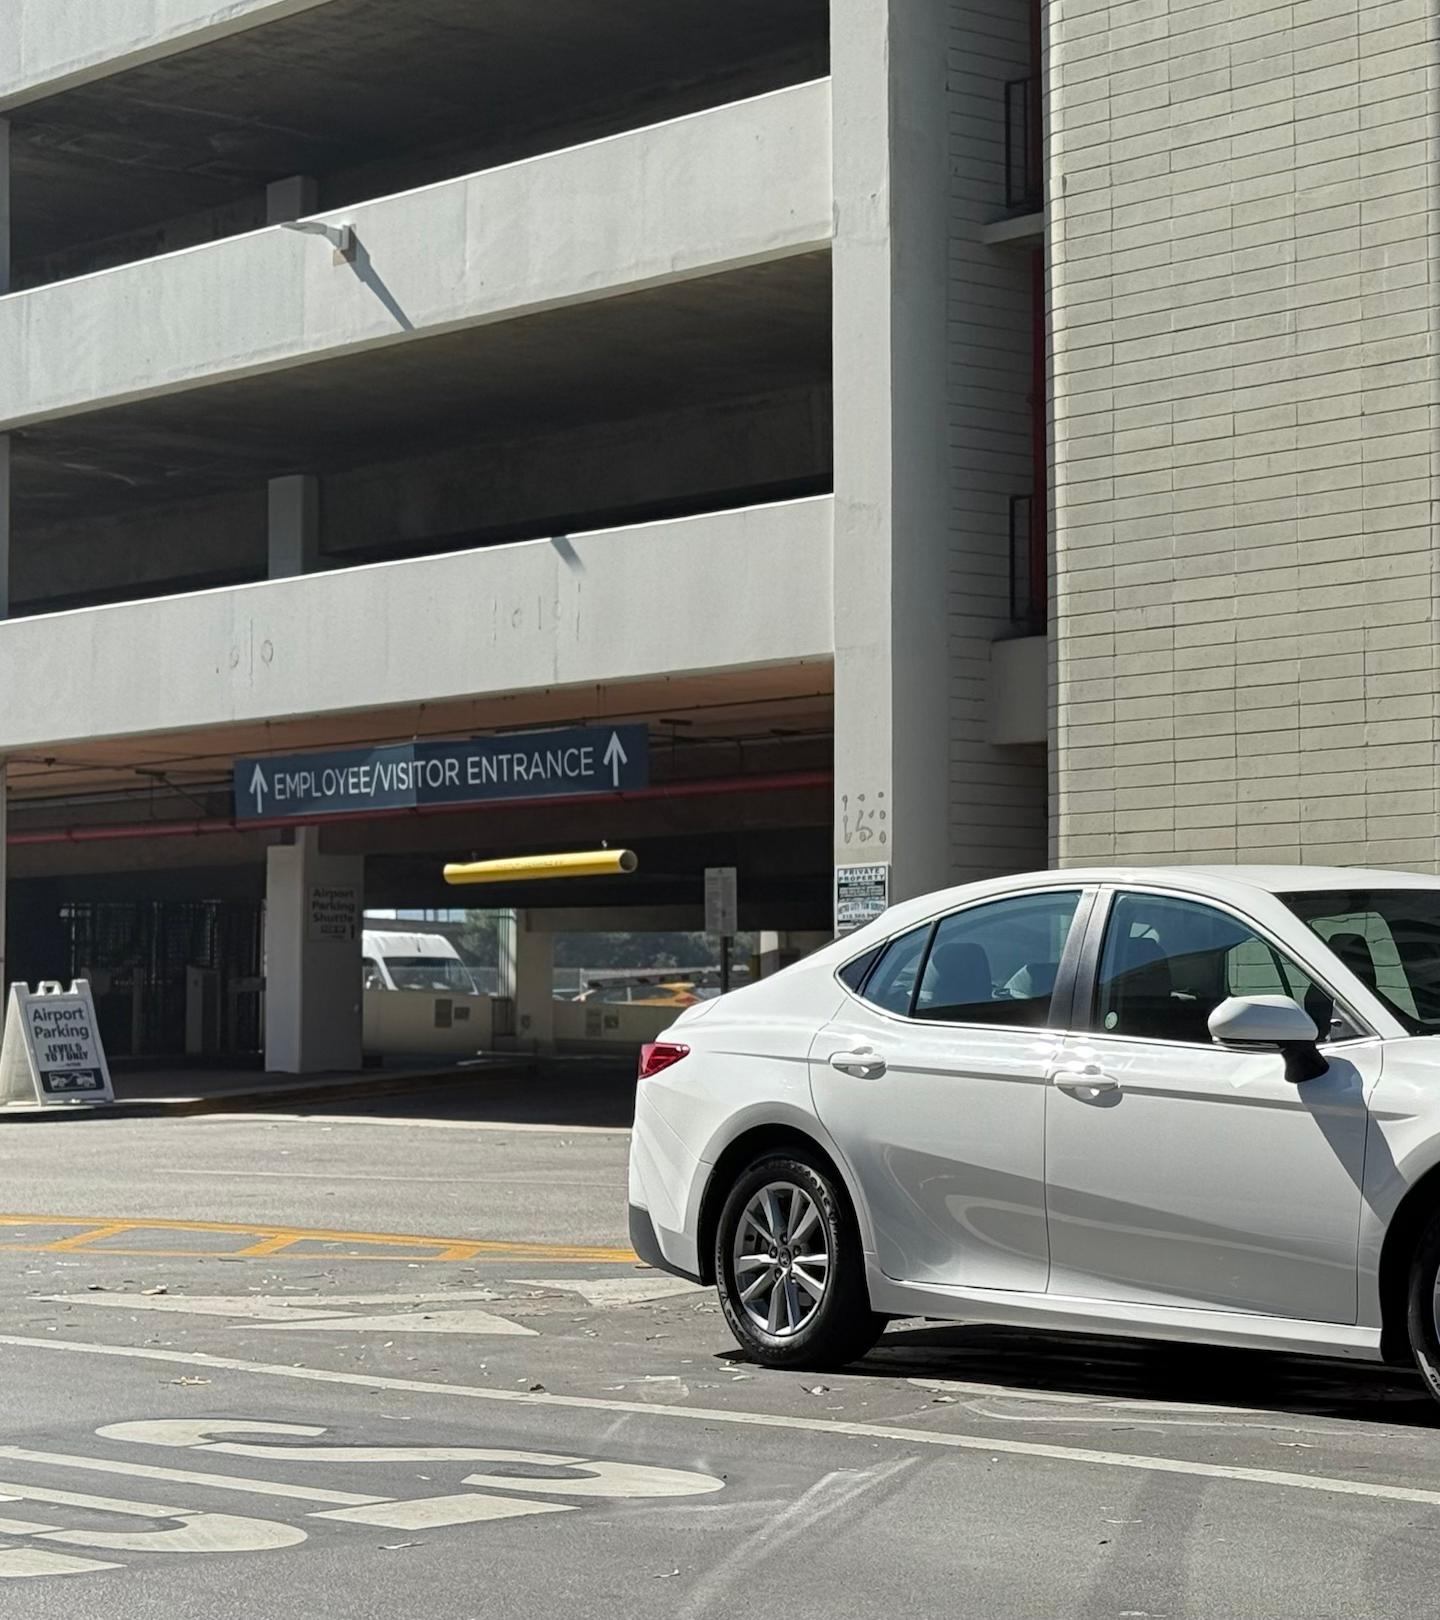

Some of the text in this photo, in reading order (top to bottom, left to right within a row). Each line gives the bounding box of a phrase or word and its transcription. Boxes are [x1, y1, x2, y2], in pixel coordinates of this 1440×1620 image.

[274, 747, 595, 800] EMPLOYEE/VISITOR ENTRANCE
[313, 888, 354, 901] Airport
[312, 900, 355, 913] Parking
[313, 912, 354, 923] Shuttle
[32, 1008, 84, 1025] Airport
[34, 1024, 89, 1040] Parking
